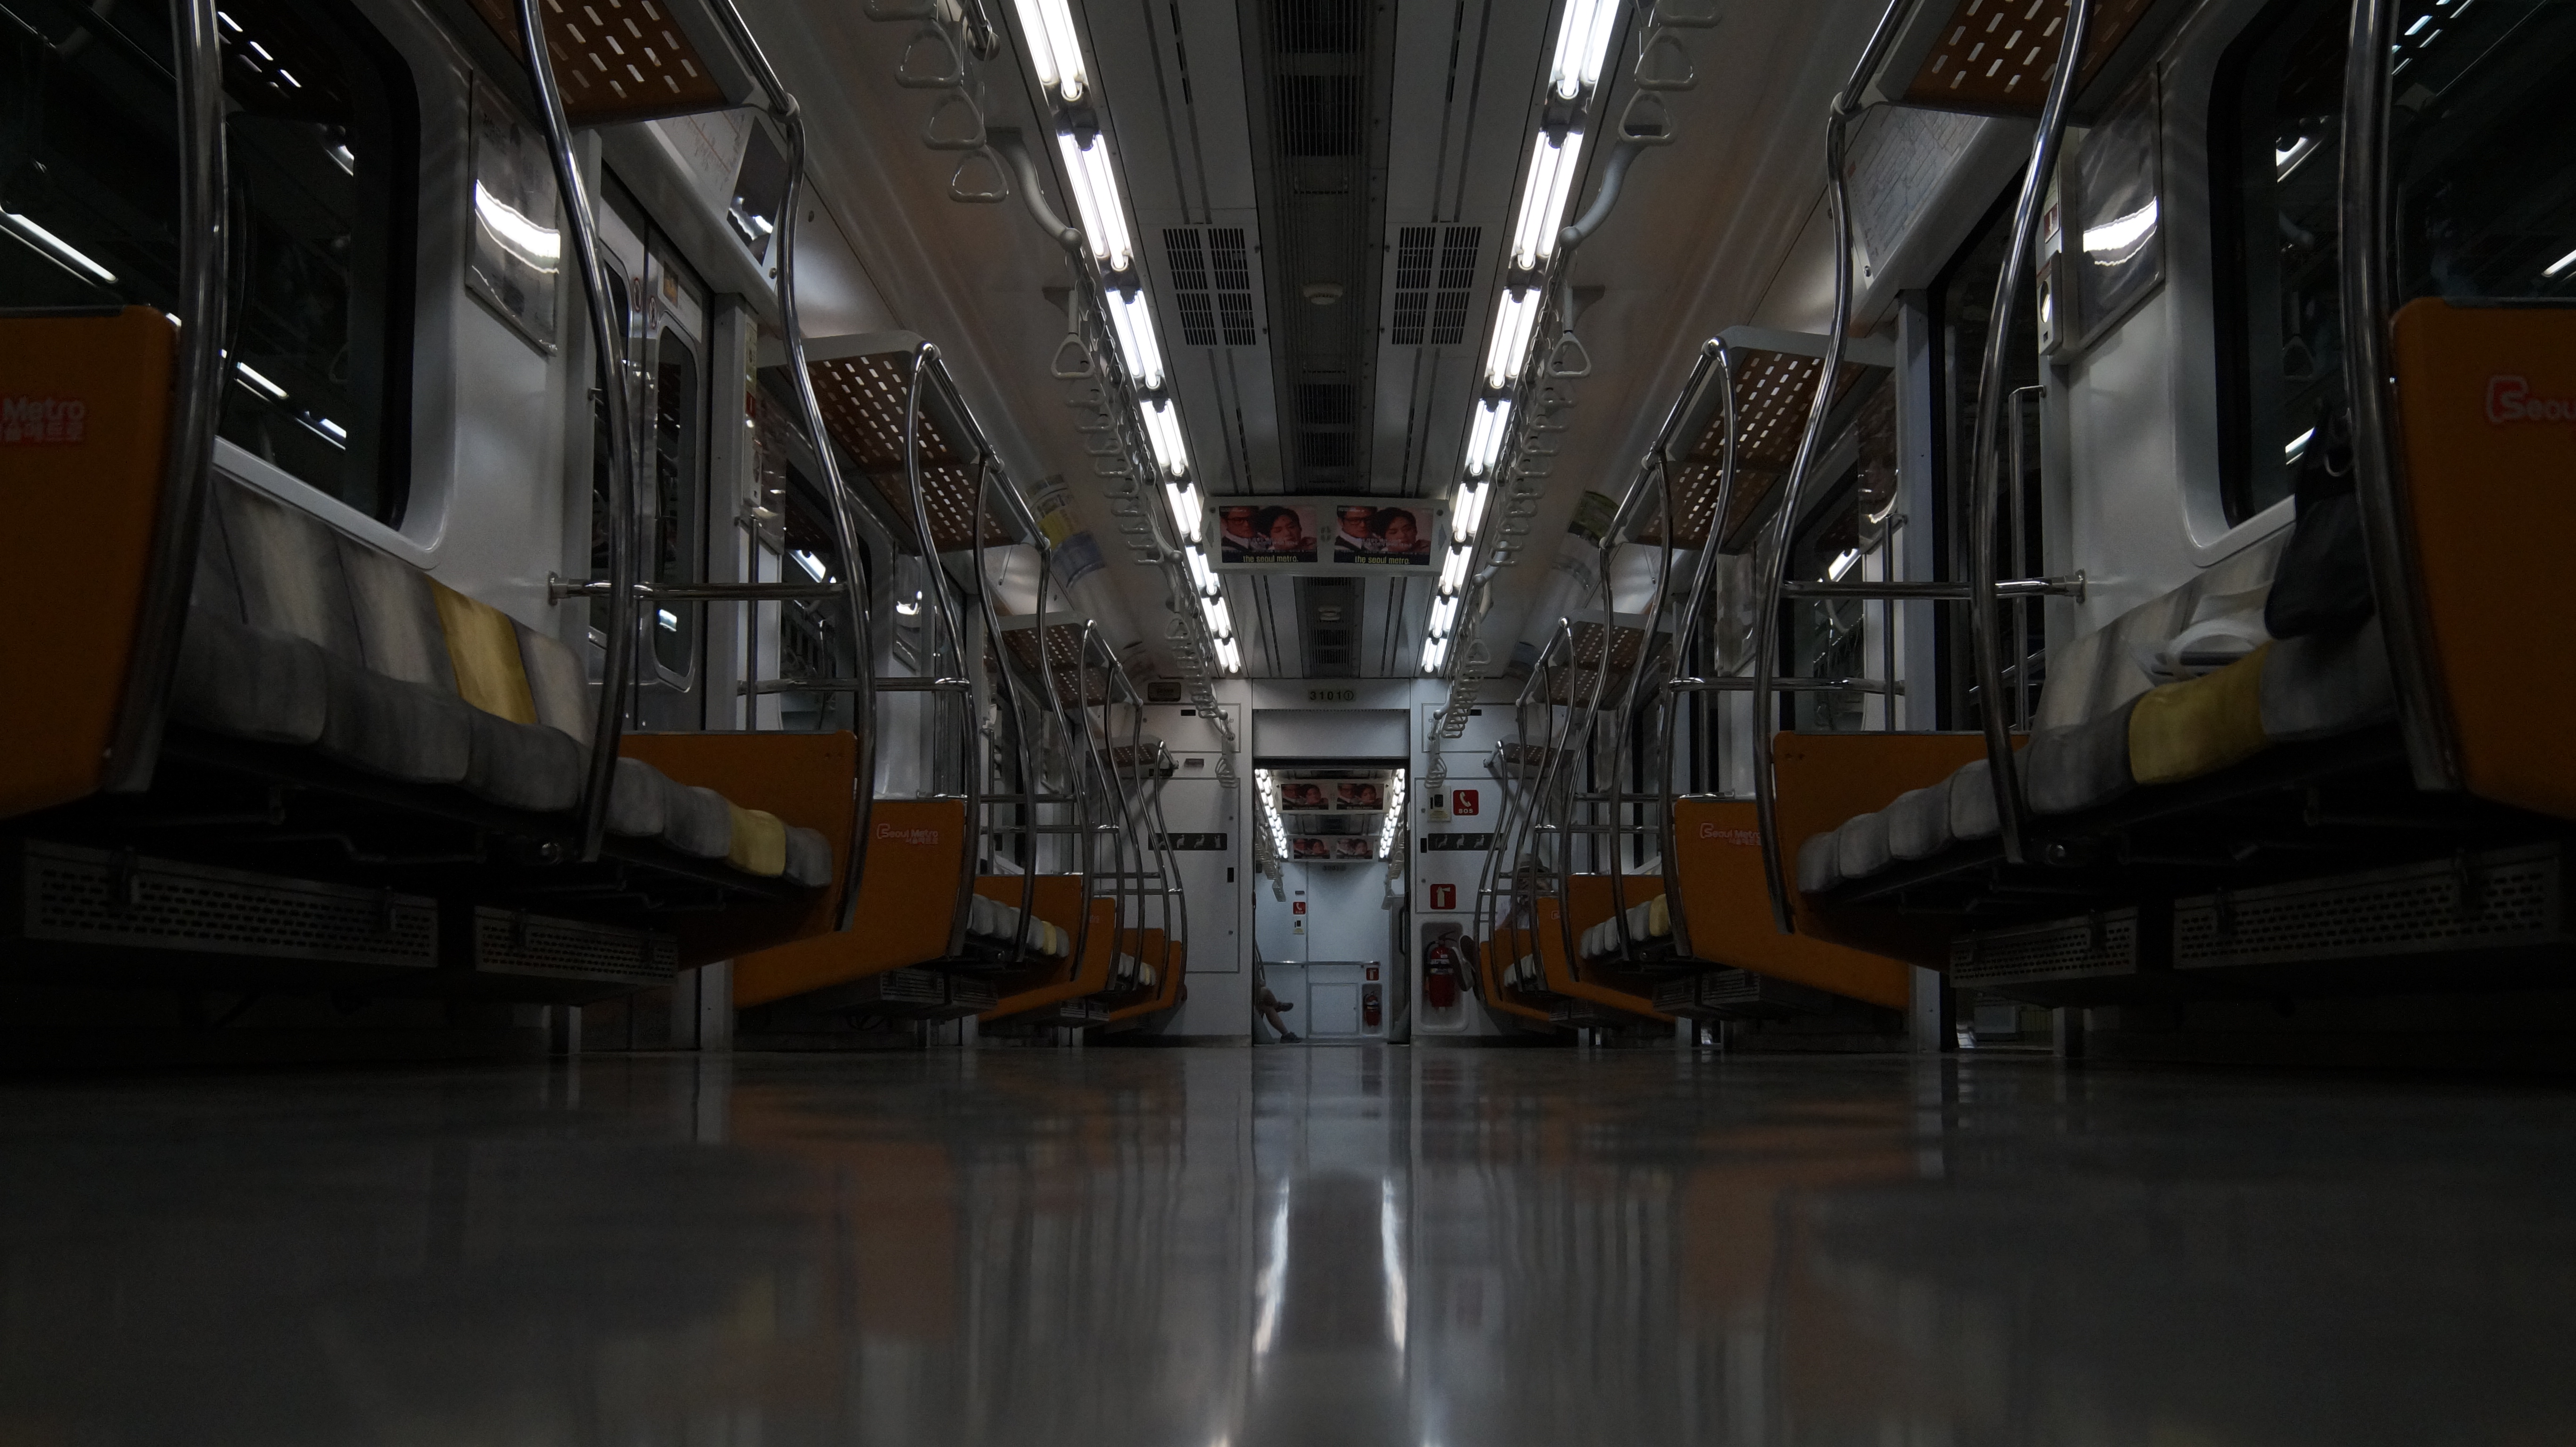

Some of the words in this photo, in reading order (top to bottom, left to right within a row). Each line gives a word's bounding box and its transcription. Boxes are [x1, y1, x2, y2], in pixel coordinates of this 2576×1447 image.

[3, 397, 85, 420] Metro
[1243, 554, 1254, 562] the
[877, 823, 909, 839] Seoul
[910, 829, 938, 838] Metro
[1700, 823, 1733, 839] Seoul
